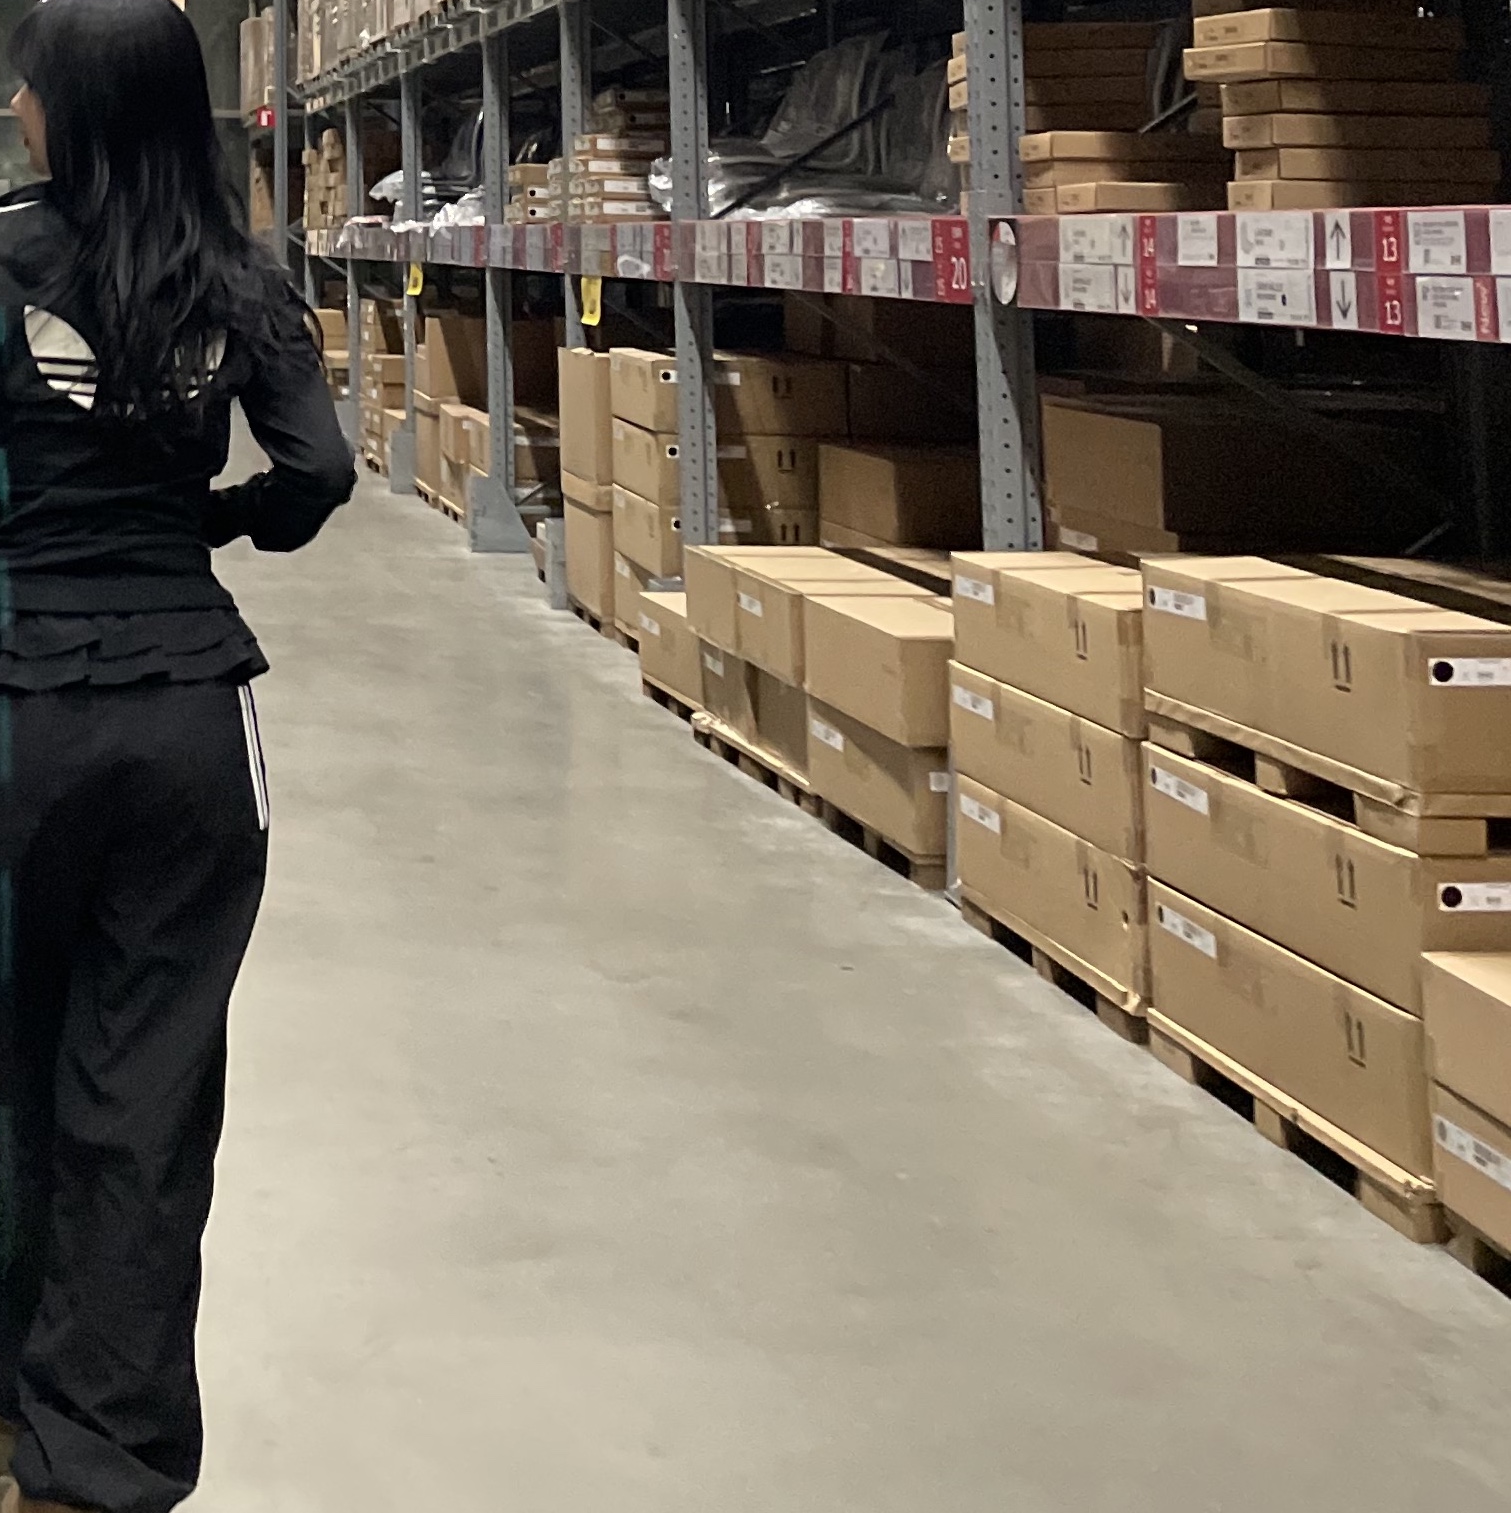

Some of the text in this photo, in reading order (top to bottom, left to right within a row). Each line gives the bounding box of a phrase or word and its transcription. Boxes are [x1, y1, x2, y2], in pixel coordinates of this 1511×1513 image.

[1143, 237, 1154, 258] 14
[1382, 236, 1398, 262] 13
[951, 255, 967, 290] 20
[1144, 288, 1157, 309] 14
[1384, 299, 1402, 326] 13
